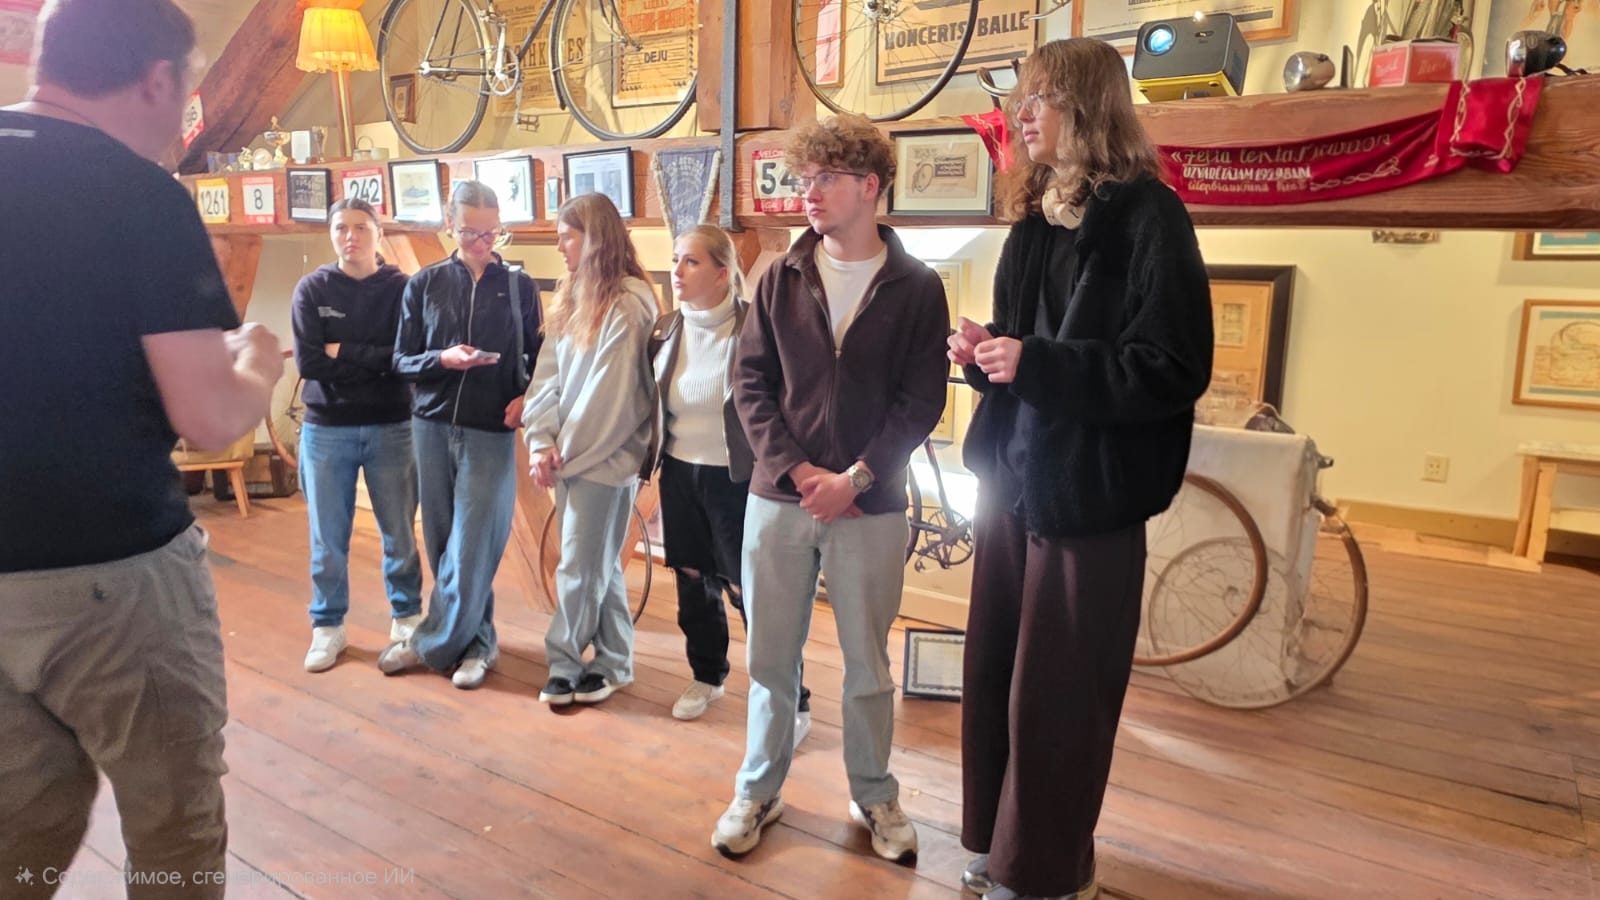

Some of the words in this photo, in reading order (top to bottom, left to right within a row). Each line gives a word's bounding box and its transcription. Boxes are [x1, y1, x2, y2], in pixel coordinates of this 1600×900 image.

[977, 10, 1030, 37] BALLE
[644, 50, 667, 63] DEJU
[254, 188, 264, 210] 8
[350, 178, 380, 203] 242
